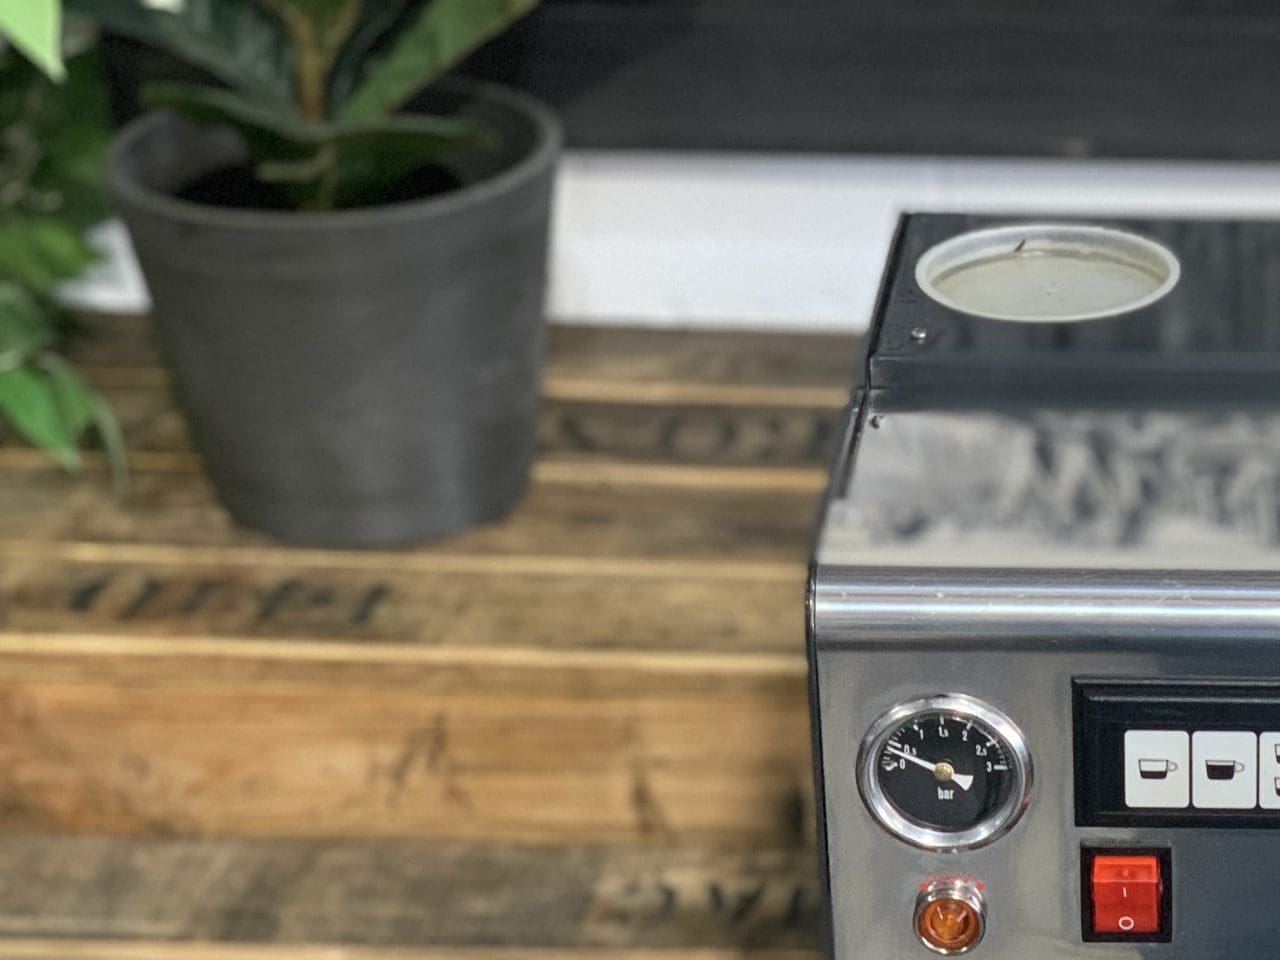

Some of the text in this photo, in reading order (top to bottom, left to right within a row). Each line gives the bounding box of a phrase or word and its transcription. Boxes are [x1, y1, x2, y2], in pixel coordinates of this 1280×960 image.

[962, 730, 968, 741] 2
[900, 759, 905, 769] 0
[986, 762, 992, 772] 3
[937, 786, 954, 800] bar
